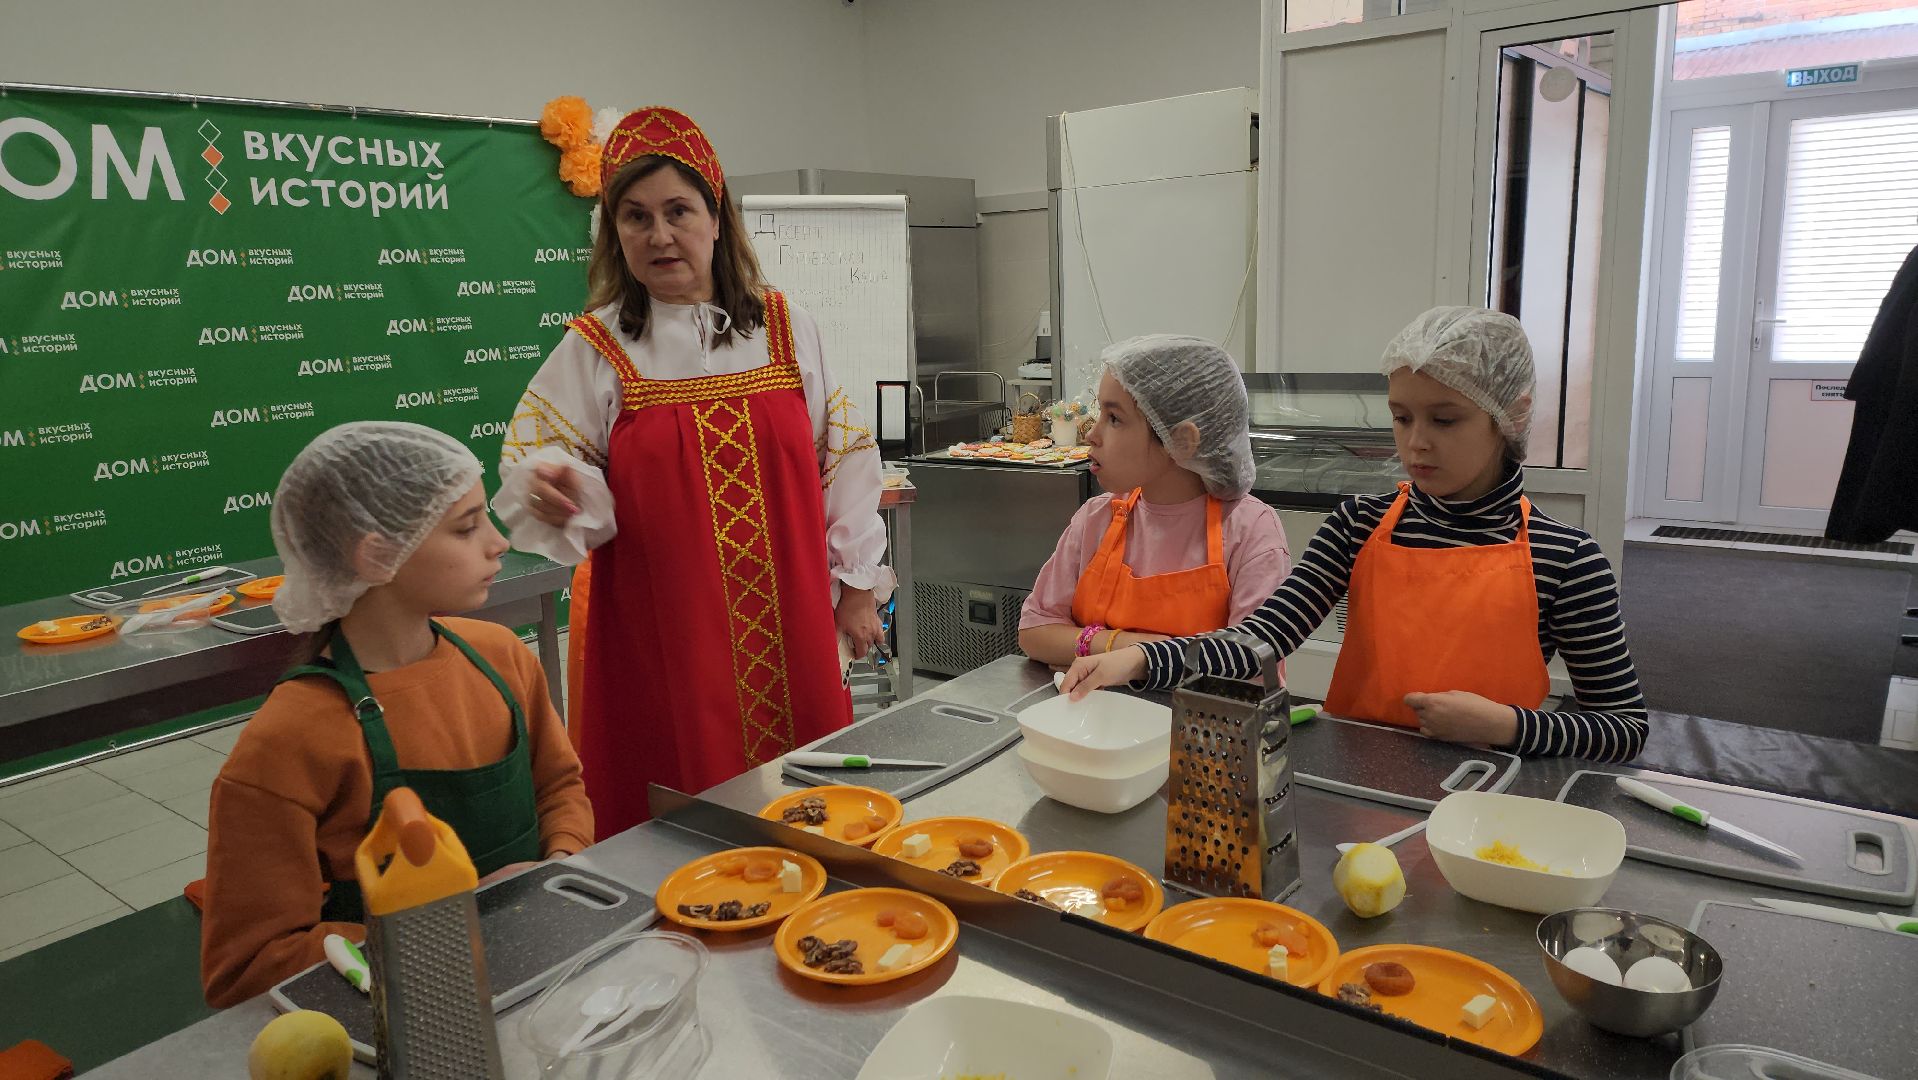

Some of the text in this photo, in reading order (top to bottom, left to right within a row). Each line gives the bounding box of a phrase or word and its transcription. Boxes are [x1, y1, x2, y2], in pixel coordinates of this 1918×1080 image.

[1790, 66, 1856, 87] ВЫХОД
[243, 130, 444, 173] вкусных
[0, 117, 185, 200] ОМ
[250, 169, 448, 217] историй
[7, 251, 61, 262] вкусных
[186, 249, 237, 267] ДОМ
[248, 248, 292, 258] вкусных
[378, 249, 421, 265] ДОМ
[429, 248, 464, 258] вкусных
[534, 248, 569, 263] ДОМ
[8, 260, 63, 270] историй
[250, 255, 293, 266] историй
[430, 256, 465, 264] историй
[343, 283, 383, 293] вкусных
[457, 281, 494, 297] ДОМ
[502, 280, 536, 289] вкусных
[131, 288, 179, 299] вкусных
[288, 285, 334, 302] ДОМ
[345, 291, 384, 300] историй
[503, 287, 536, 295] историй
[61, 291, 118, 310] ДОМ
[132, 297, 181, 307] историй
[436, 316, 471, 325] вкусных
[539, 312, 575, 328] ДОМ
[259, 324, 303, 334] вкусных
[386, 318, 427, 336] ДОМ
[437, 321, 472, 332] историй
[22, 334, 75, 344] вкусных
[199, 327, 248, 345] ДОМ
[261, 332, 304, 341] историй
[23, 342, 77, 353] историй
[509, 345, 540, 353] вкусных
[352, 354, 391, 364] вкусных
[464, 348, 501, 364] ДОМ
[510, 350, 541, 360] историй
[298, 358, 343, 376] ДОМ
[353, 360, 392, 371] историй
[148, 368, 195, 378] вкусных
[80, 373, 136, 393] ДОМ
[149, 376, 197, 386] историй
[443, 387, 478, 396] вкусных
[395, 391, 435, 409] ДОМ
[444, 394, 479, 403] историй
[271, 402, 313, 413] вкусных
[211, 408, 260, 428] ДОМ
[272, 410, 314, 420] историй
[38, 423, 91, 435] вкусных
[470, 422, 508, 439] ДОМ
[40, 432, 92, 444] историй
[161, 451, 208, 463] вкусных
[94, 458, 149, 481] ДОМ
[163, 458, 209, 470] историй
[224, 493, 271, 515] ДОМ
[54, 510, 105, 523] вкусных
[0, 520, 41, 539] ОМ
[56, 515, 106, 532] историй
[176, 544, 221, 558] вкусных
[177, 552, 224, 568] историй
[111, 555, 164, 579] ДОМ
